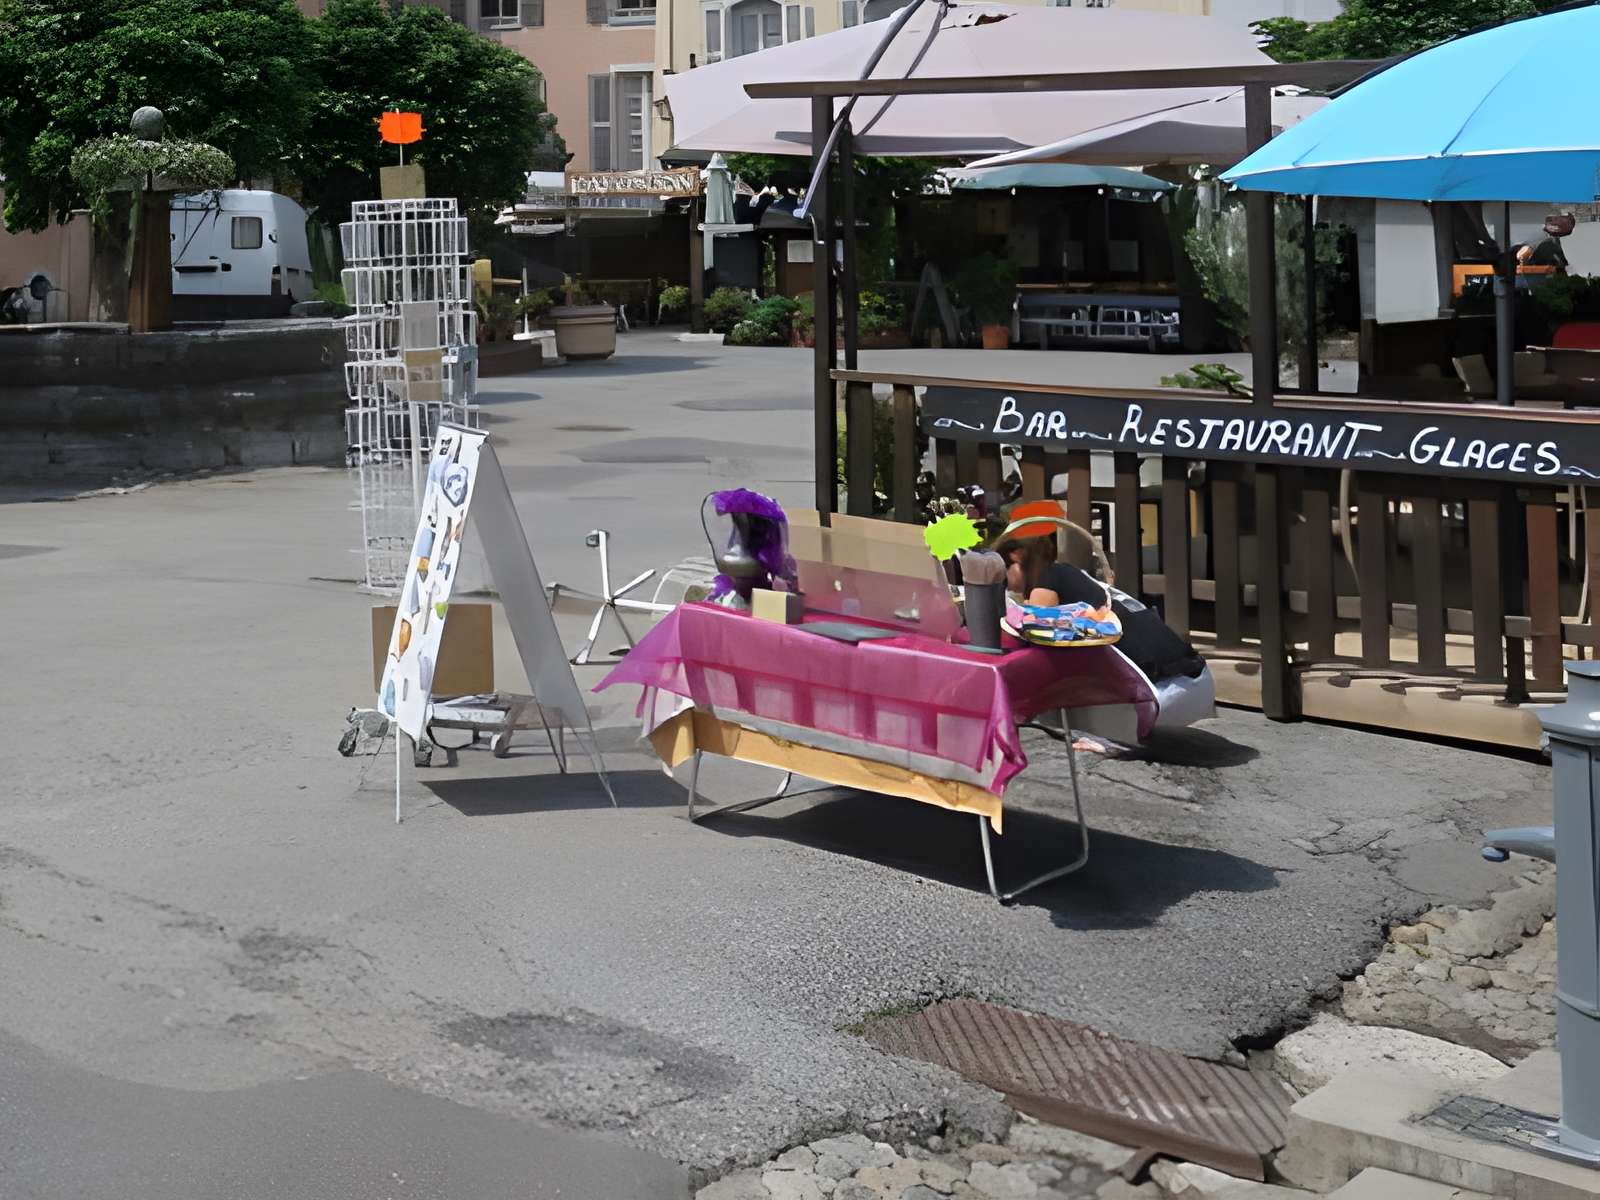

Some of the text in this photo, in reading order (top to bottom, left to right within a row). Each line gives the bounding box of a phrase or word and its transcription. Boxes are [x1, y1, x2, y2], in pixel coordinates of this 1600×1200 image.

[993, 397, 1561, 475] BAR RESTAURANT GLACES
